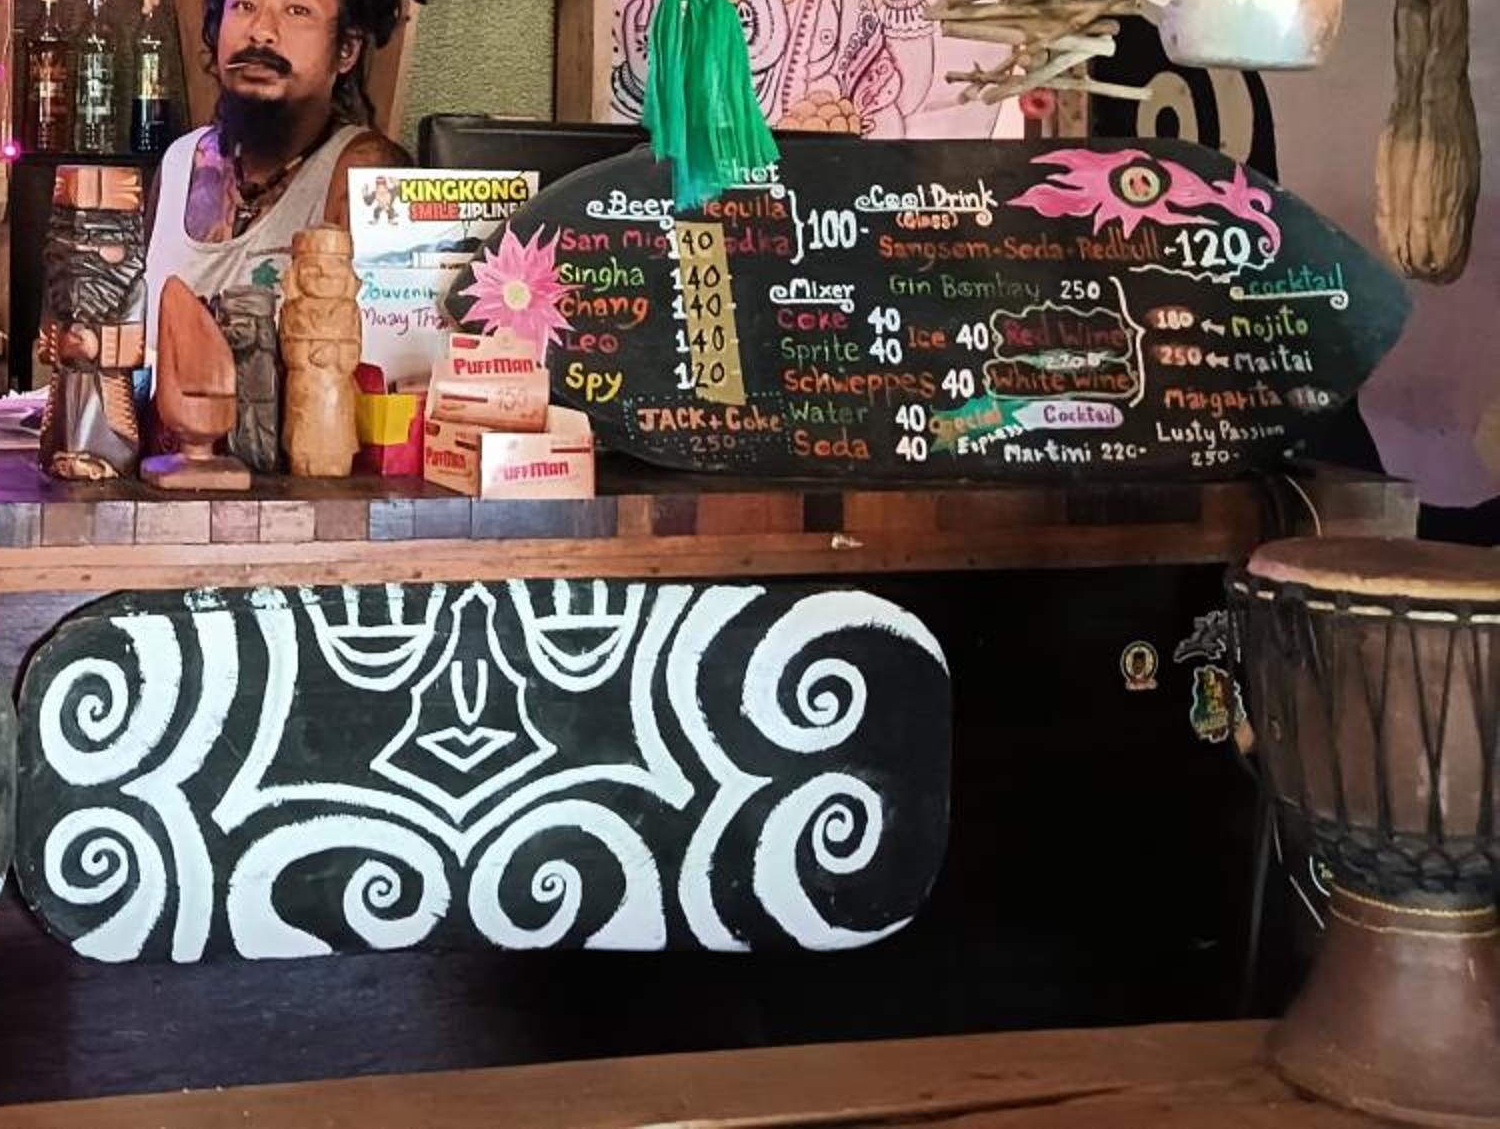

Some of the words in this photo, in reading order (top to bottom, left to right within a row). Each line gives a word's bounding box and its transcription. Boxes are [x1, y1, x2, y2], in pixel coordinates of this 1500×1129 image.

[400, 174, 528, 202] KINGKONG
[607, 189, 674, 216] Beer
[870, 184, 925, 209] Cool
[931, 178, 999, 209] Drink
[559, 229, 609, 252] San
[559, 257, 645, 292] Singha
[790, 278, 855, 300] Mixer
[889, 274, 932, 296] Gin
[1060, 279, 1101, 300] 250
[1249, 262, 1346, 292] cocktail
[559, 291, 649, 330] Chang
[777, 308, 848, 331] Coke
[866, 305, 901, 334] 40
[1230, 305, 1309, 342] Mojito
[566, 333, 619, 353] Leo
[780, 335, 862, 368] Sprite
[868, 335, 903, 365] 40
[907, 325, 948, 349] Ice
[955, 322, 989, 352] 40
[1159, 345, 1203, 366] 250
[1233, 344, 1313, 372] Maitai
[565, 362, 623, 403] Spy
[781, 365, 937, 407] Schweppes
[940, 368, 975, 399] 40
[1164, 380, 1284, 419] Margarita
[789, 401, 869, 424] Water
[895, 404, 926, 433] 40
[1043, 405, 1116, 425] Cocktail
[792, 427, 871, 460] Soda
[895, 435, 928, 463] 40
[1155, 419, 1217, 450] Lusty
[1003, 438, 1092, 464] Martini
